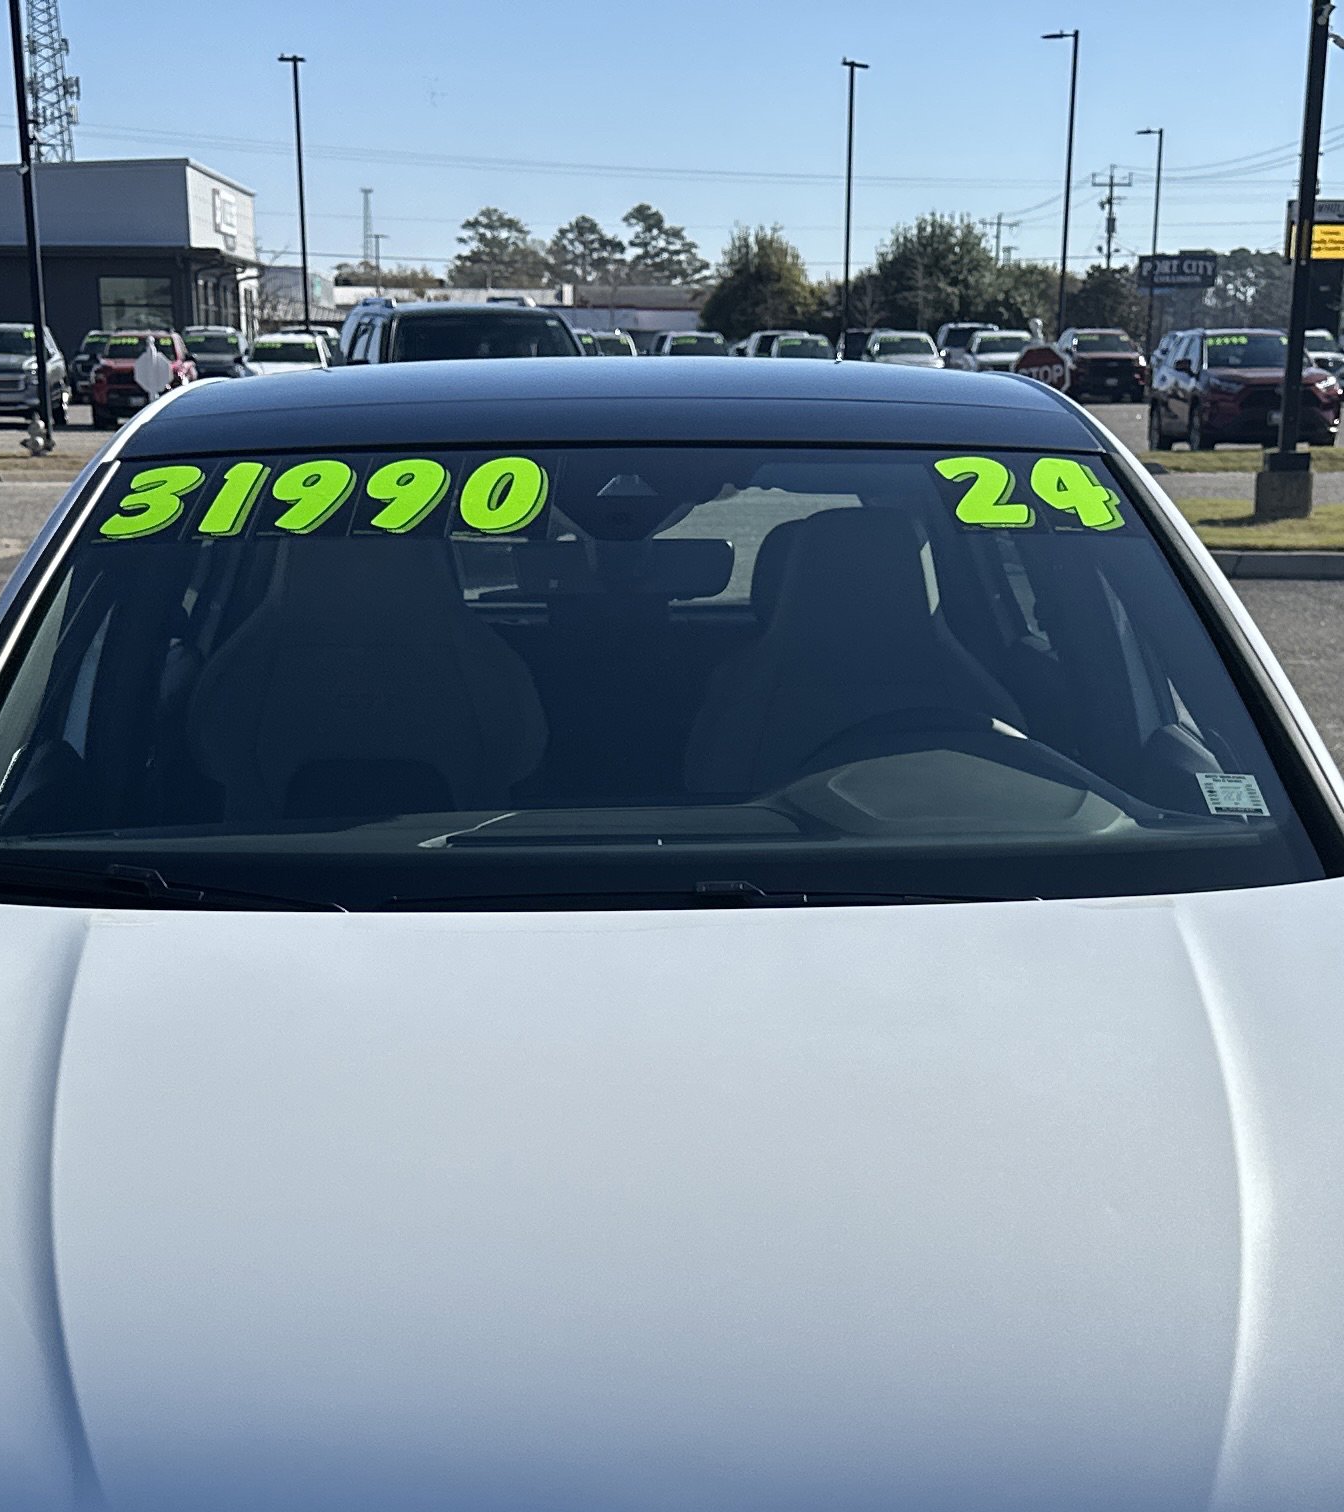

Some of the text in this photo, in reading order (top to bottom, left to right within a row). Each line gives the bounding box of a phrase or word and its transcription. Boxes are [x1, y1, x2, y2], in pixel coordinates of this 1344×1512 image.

[1182, 260, 1215, 275] CITY
[99, 456, 1126, 540] 31990 24
